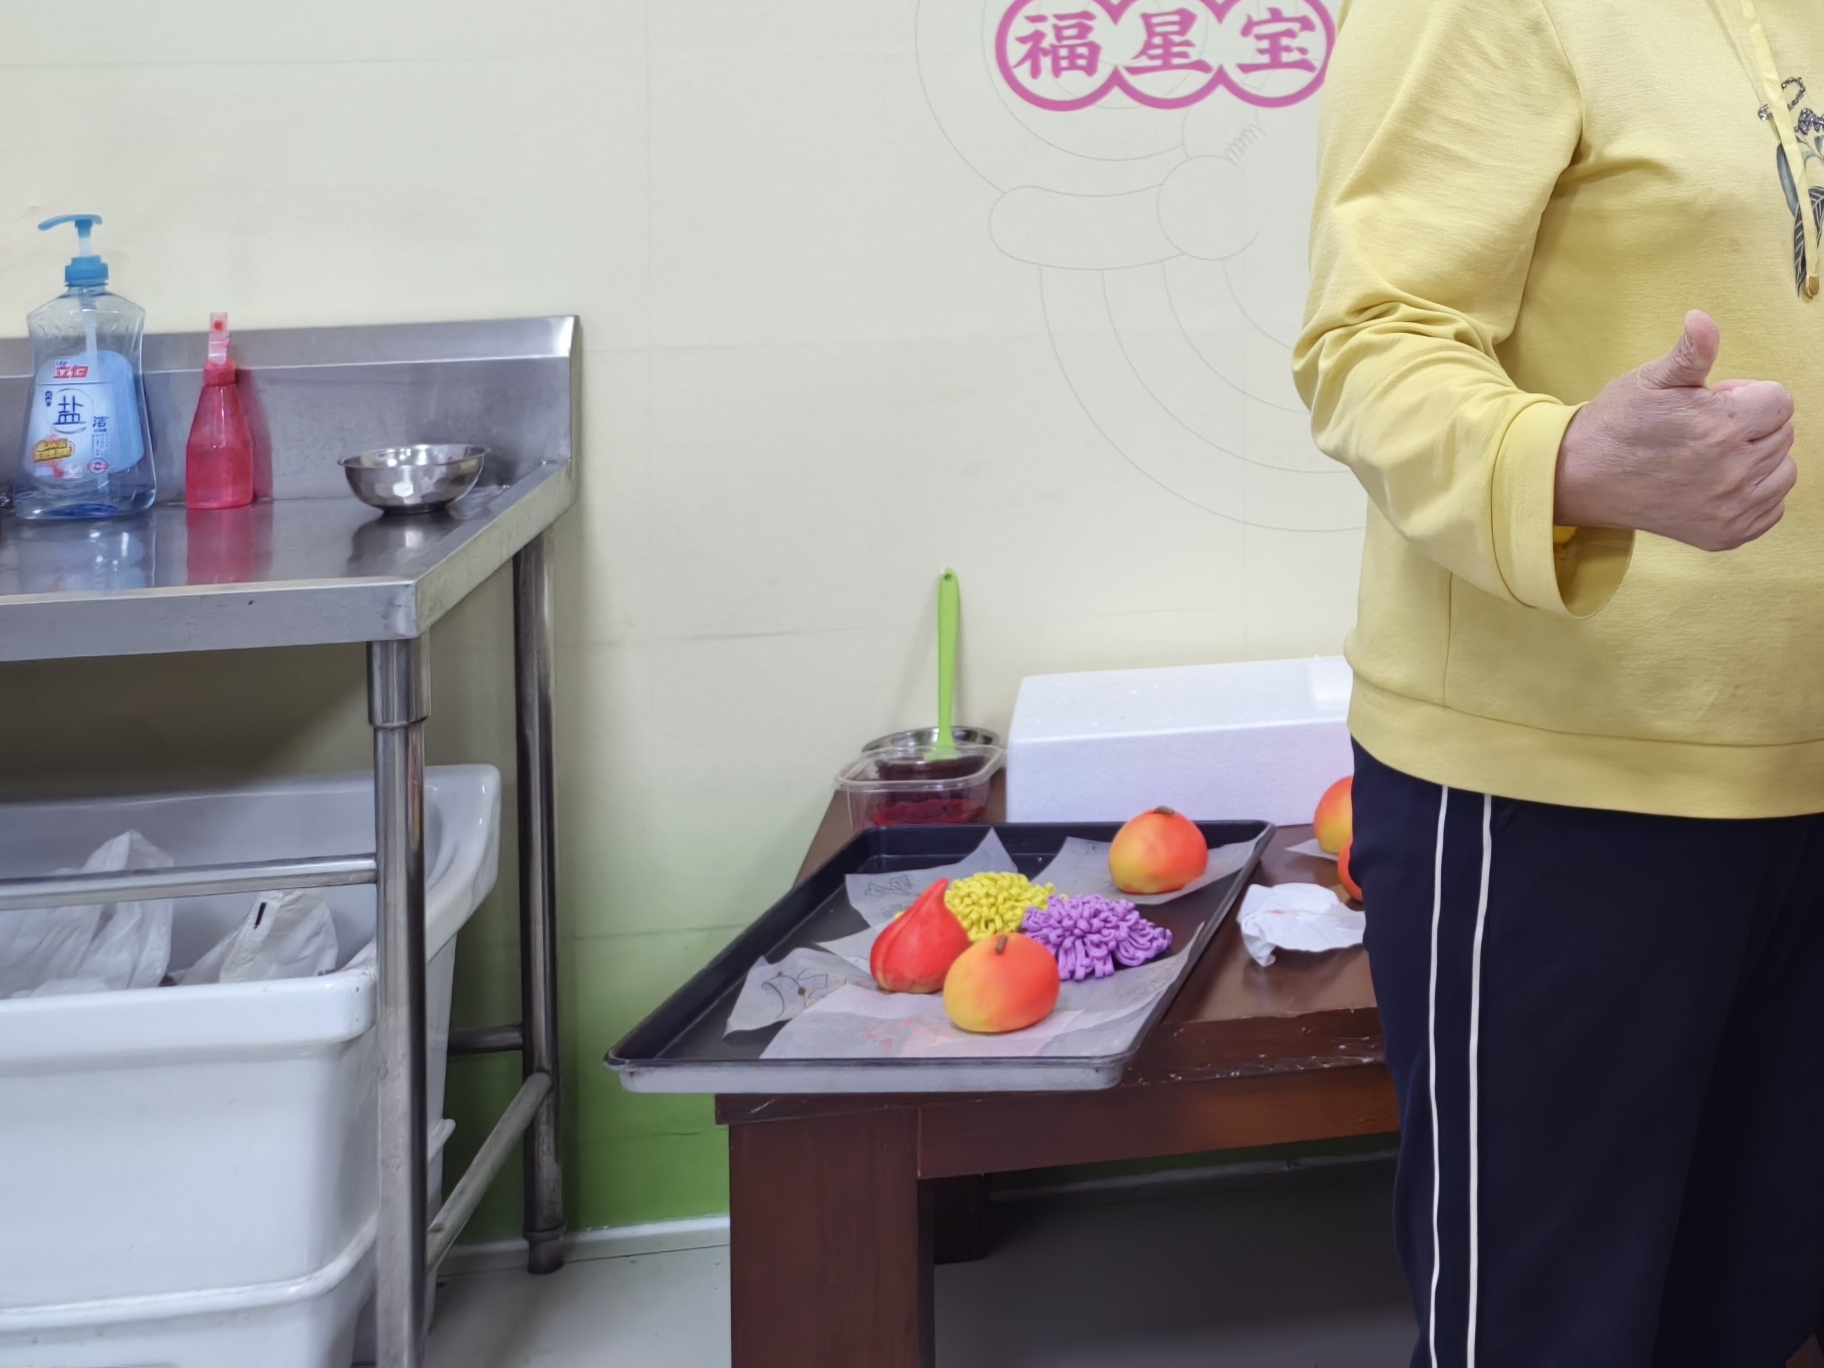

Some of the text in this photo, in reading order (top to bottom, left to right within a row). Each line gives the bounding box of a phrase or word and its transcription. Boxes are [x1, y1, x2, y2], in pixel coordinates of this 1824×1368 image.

[1012, 6, 1319, 80] 福星宝
[53, 395, 87, 425] 盐
